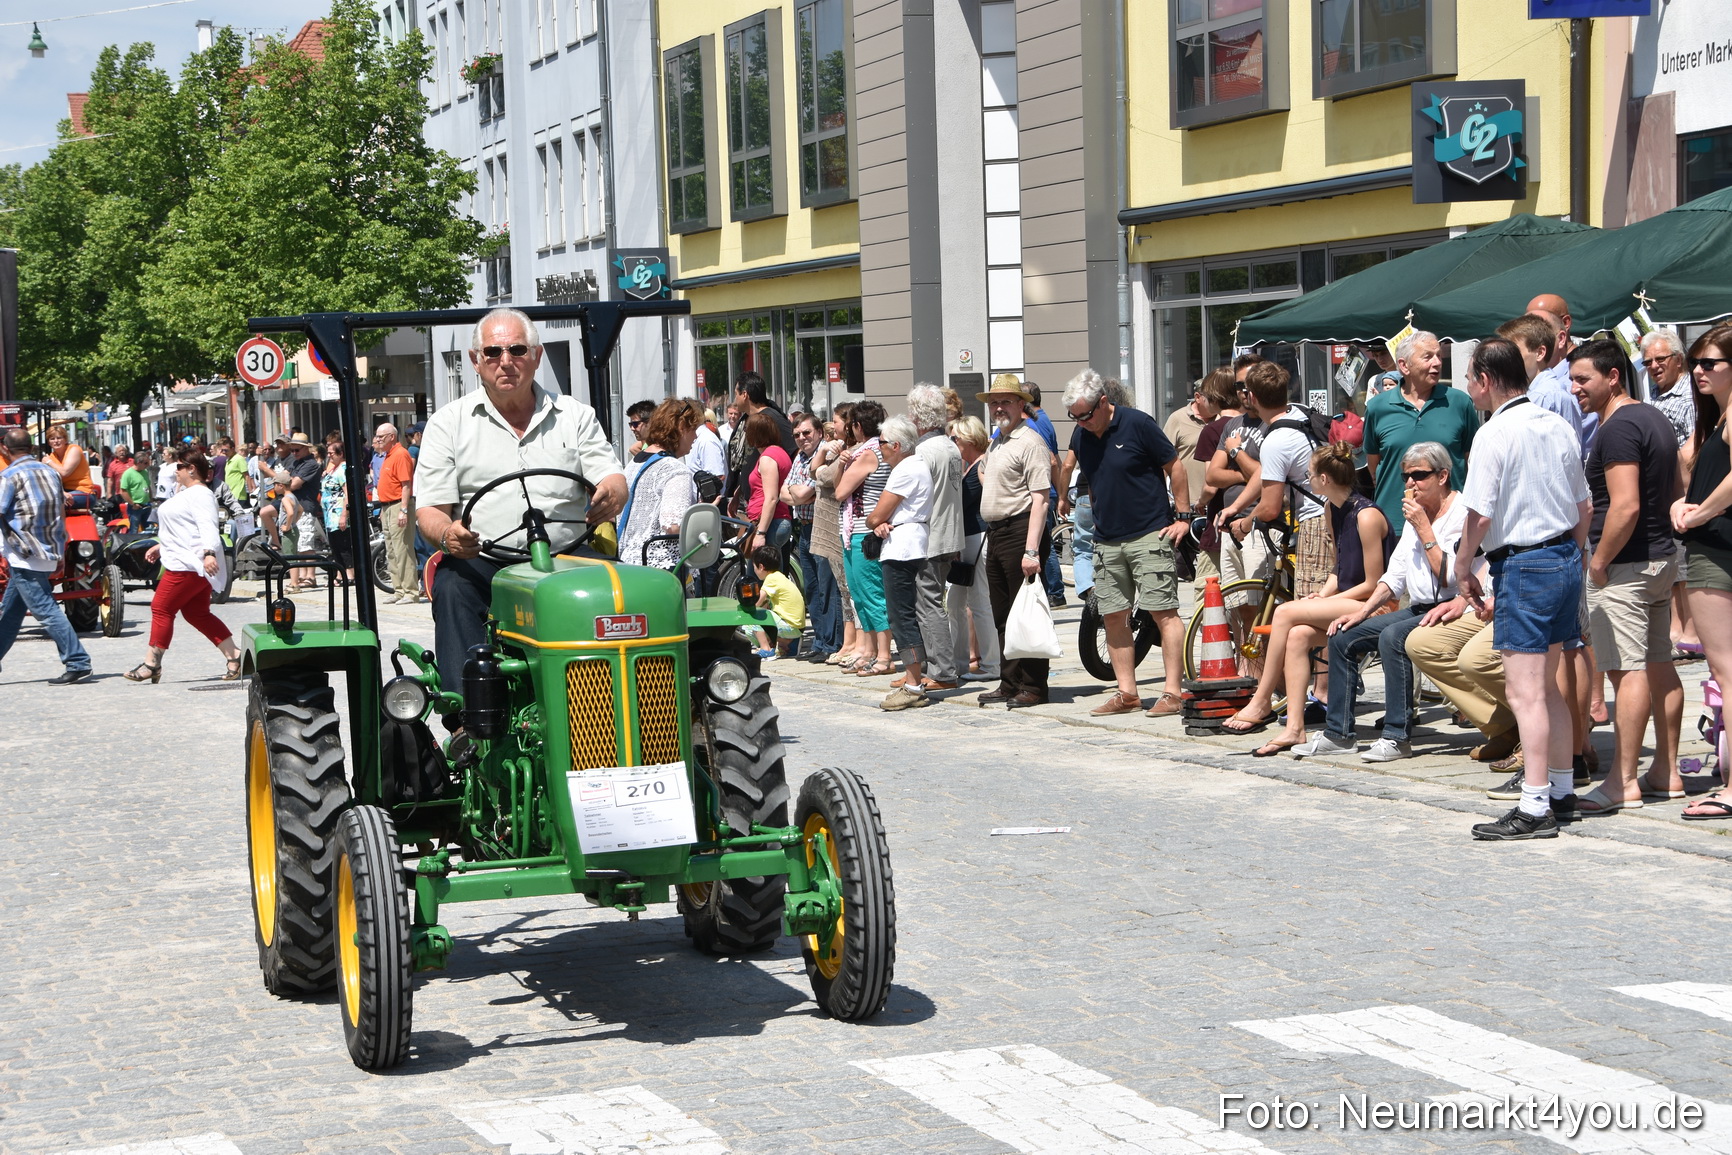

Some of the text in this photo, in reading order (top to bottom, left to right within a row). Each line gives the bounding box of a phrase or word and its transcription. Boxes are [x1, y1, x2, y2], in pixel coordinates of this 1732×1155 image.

[1661, 49, 1702, 75] Unterer
[1460, 113, 1498, 162] G2
[632, 264, 653, 290] G2
[247, 350, 275, 373] 30
[601, 615, 642, 637] Bautz
[626, 781, 666, 798] 270
